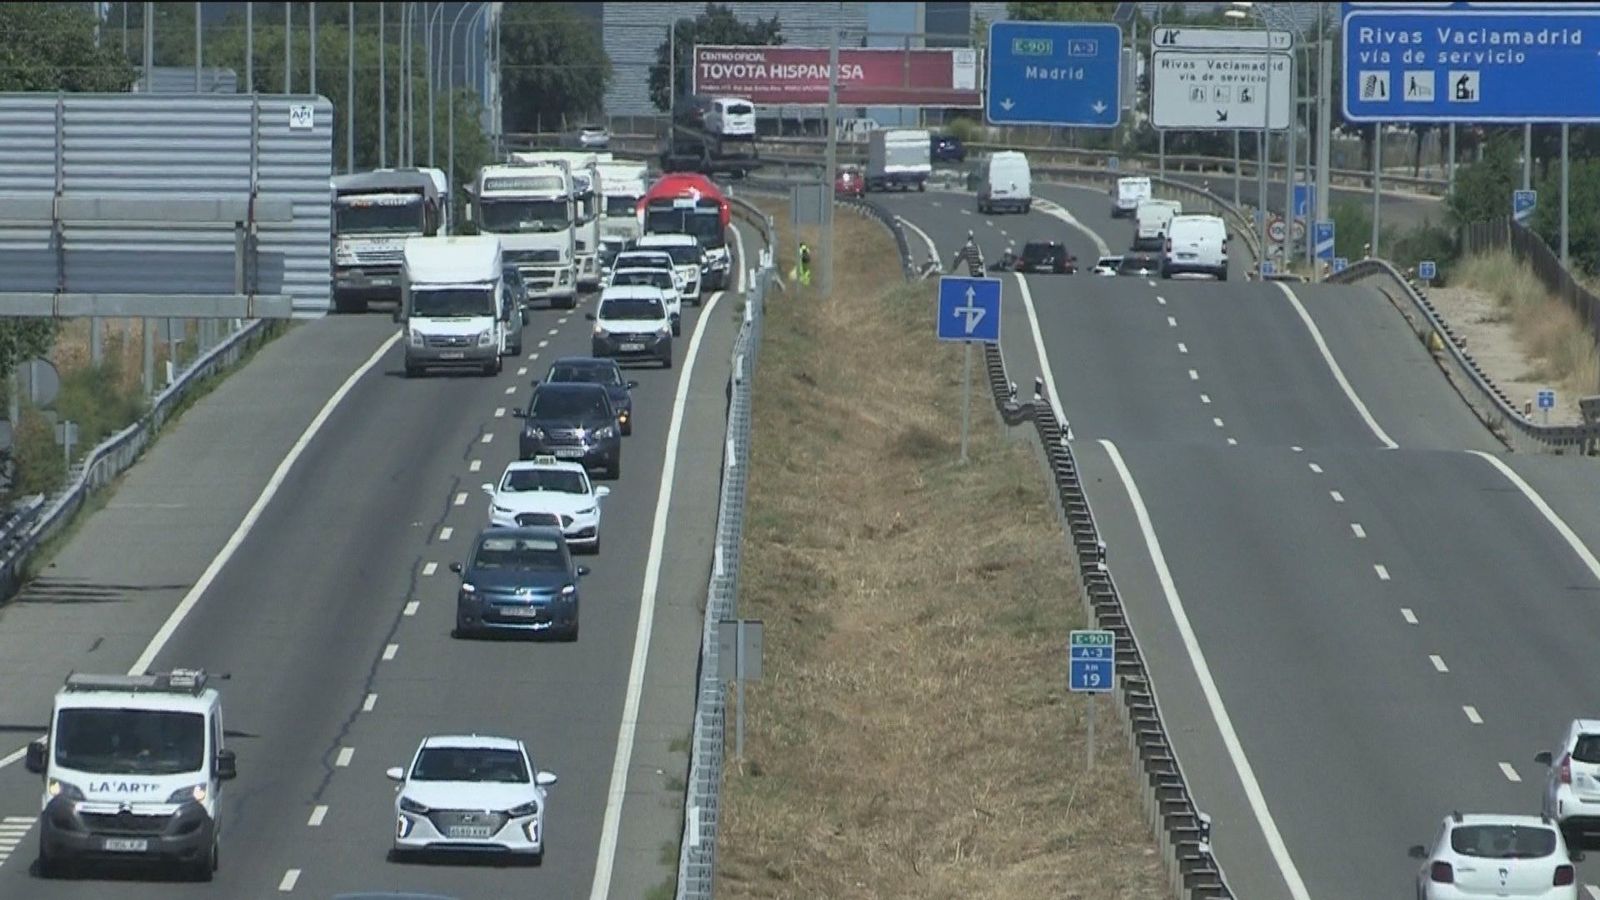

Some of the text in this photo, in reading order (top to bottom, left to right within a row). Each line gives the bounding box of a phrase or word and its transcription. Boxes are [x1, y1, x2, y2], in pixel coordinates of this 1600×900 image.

[1359, 27, 1582, 45] Rivas Vaciamadrid
[1073, 42, 1094, 53] A-3
[700, 52, 767, 62] CENTRO OFICIAL
[1402, 49, 1426, 64] de
[1437, 49, 1526, 64] servicio
[1161, 60, 1196, 69] Rivas
[700, 63, 767, 79] TOYOTA
[1025, 65, 1084, 80] Madrid
[1202, 73, 1214, 82] de
[1220, 74, 1267, 83] servicio
[1076, 634, 1109, 645] E-901
[1081, 647, 1103, 658] A-3
[1085, 663, 1099, 671] km
[1082, 673, 1101, 687] 19
